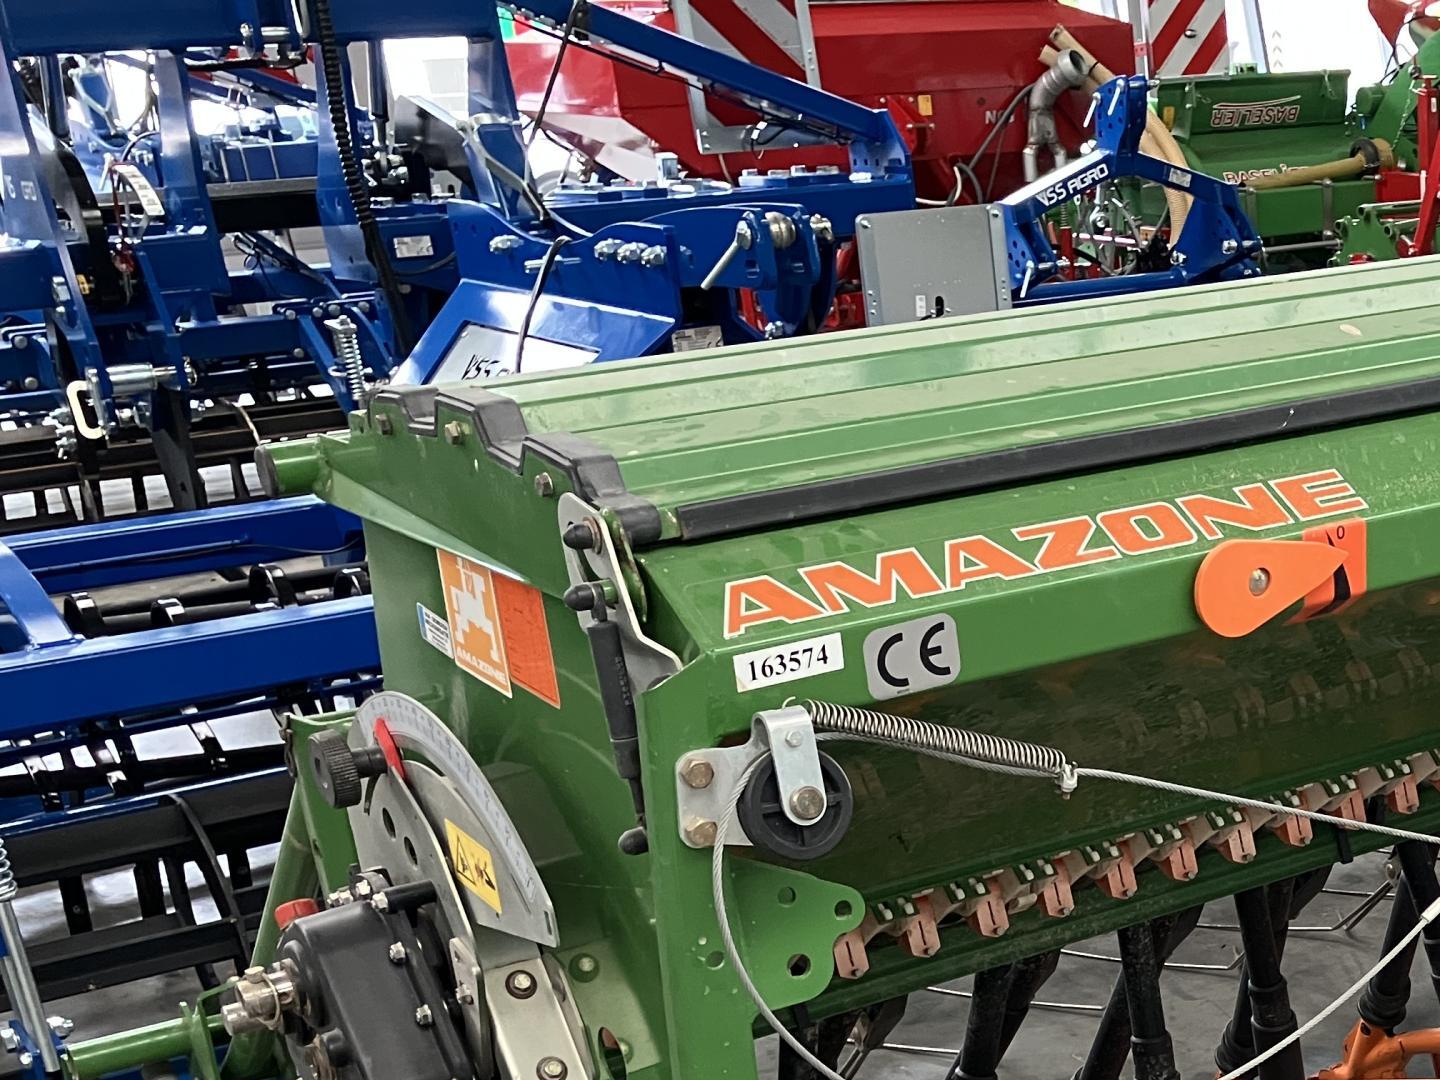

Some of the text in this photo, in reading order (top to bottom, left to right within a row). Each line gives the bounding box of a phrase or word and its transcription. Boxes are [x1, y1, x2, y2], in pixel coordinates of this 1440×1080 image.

[1035, 163, 1109, 206] VSS AGRO
[723, 468, 1369, 640] AMAZONE
[748, 644, 829, 682] 163574
[877, 621, 951, 688] CE
